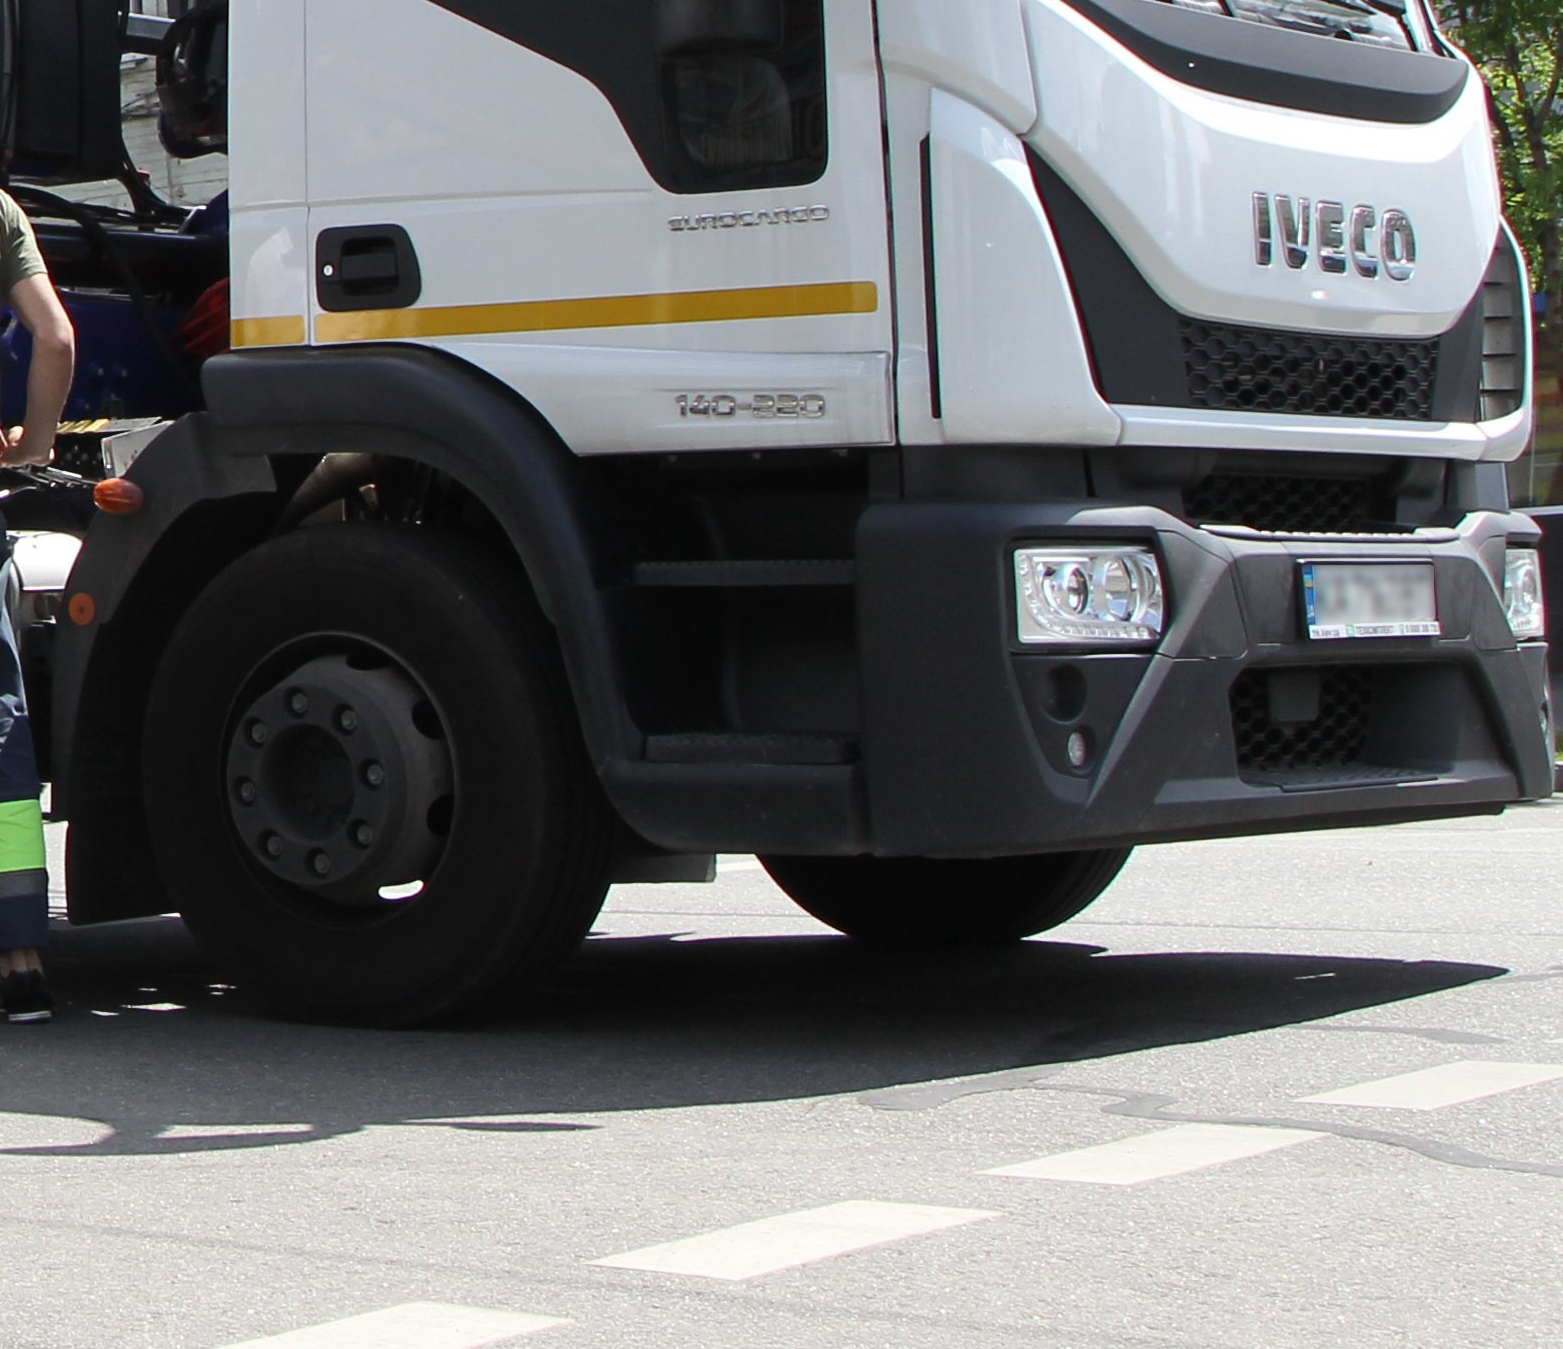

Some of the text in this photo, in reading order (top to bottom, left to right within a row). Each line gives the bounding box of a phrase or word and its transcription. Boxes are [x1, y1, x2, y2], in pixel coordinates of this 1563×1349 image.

[667, 204, 831, 231] EUROCARGO
[1251, 191, 1418, 282] IVECO
[674, 394, 826, 419] 140-220
